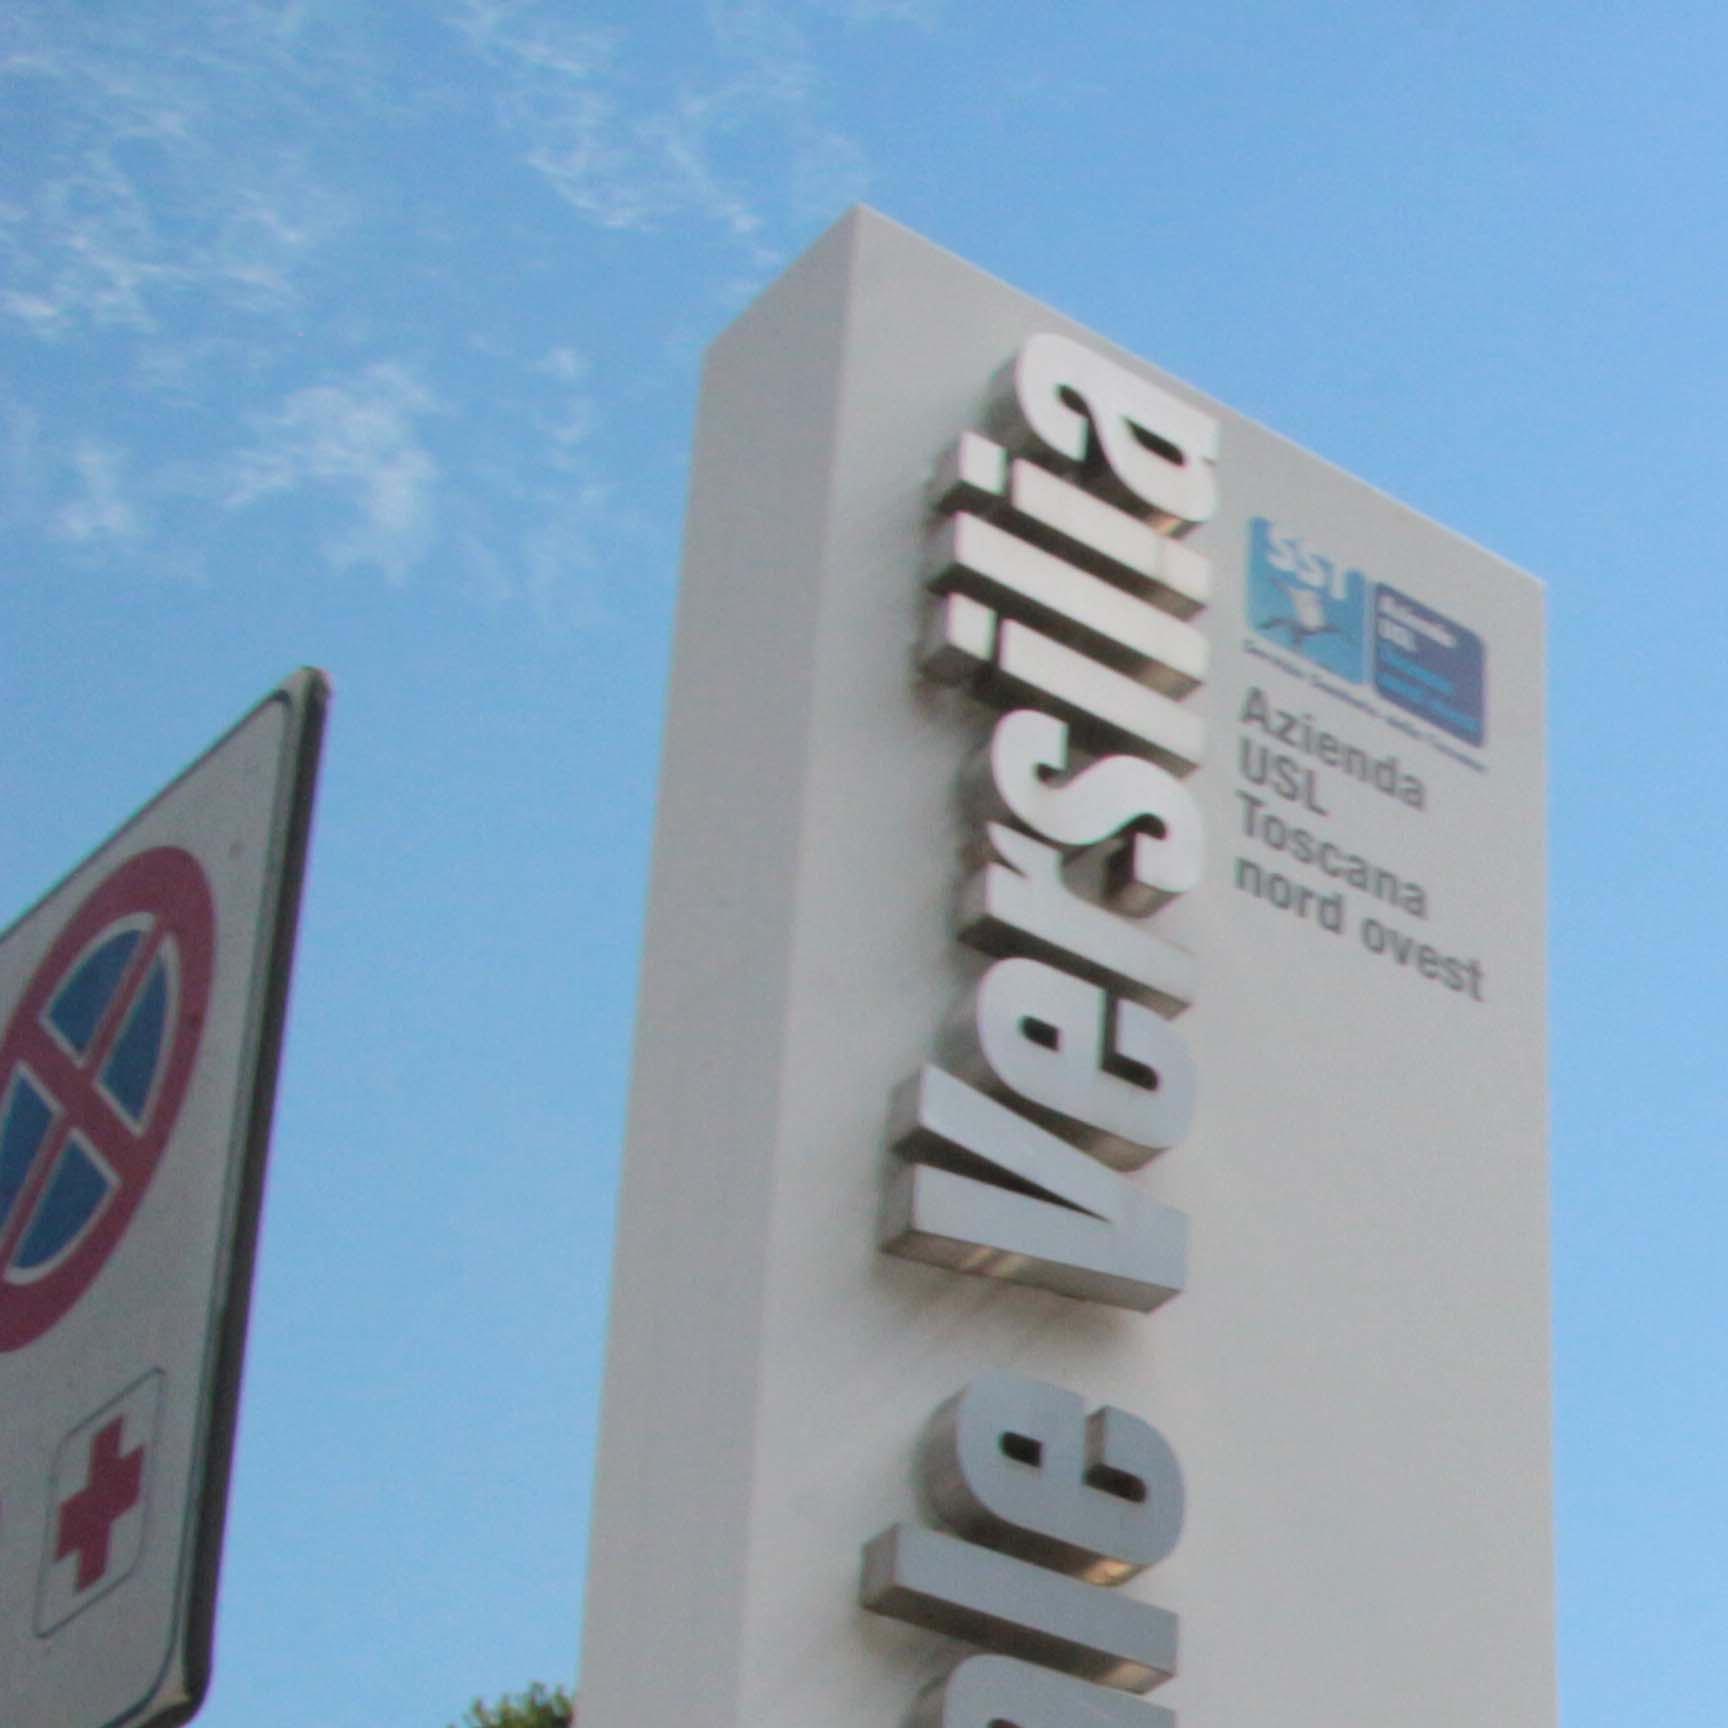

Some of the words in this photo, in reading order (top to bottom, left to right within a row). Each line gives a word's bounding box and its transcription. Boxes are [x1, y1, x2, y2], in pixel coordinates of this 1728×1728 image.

[1238, 686, 1426, 811] Azienda
[1238, 736, 1329, 817] USL
[888, 332, 1219, 1311] Versilia
[1235, 788, 1428, 920] Toscana
[1236, 857, 1343, 934] nord
[1361, 917, 1484, 1002] ovest
